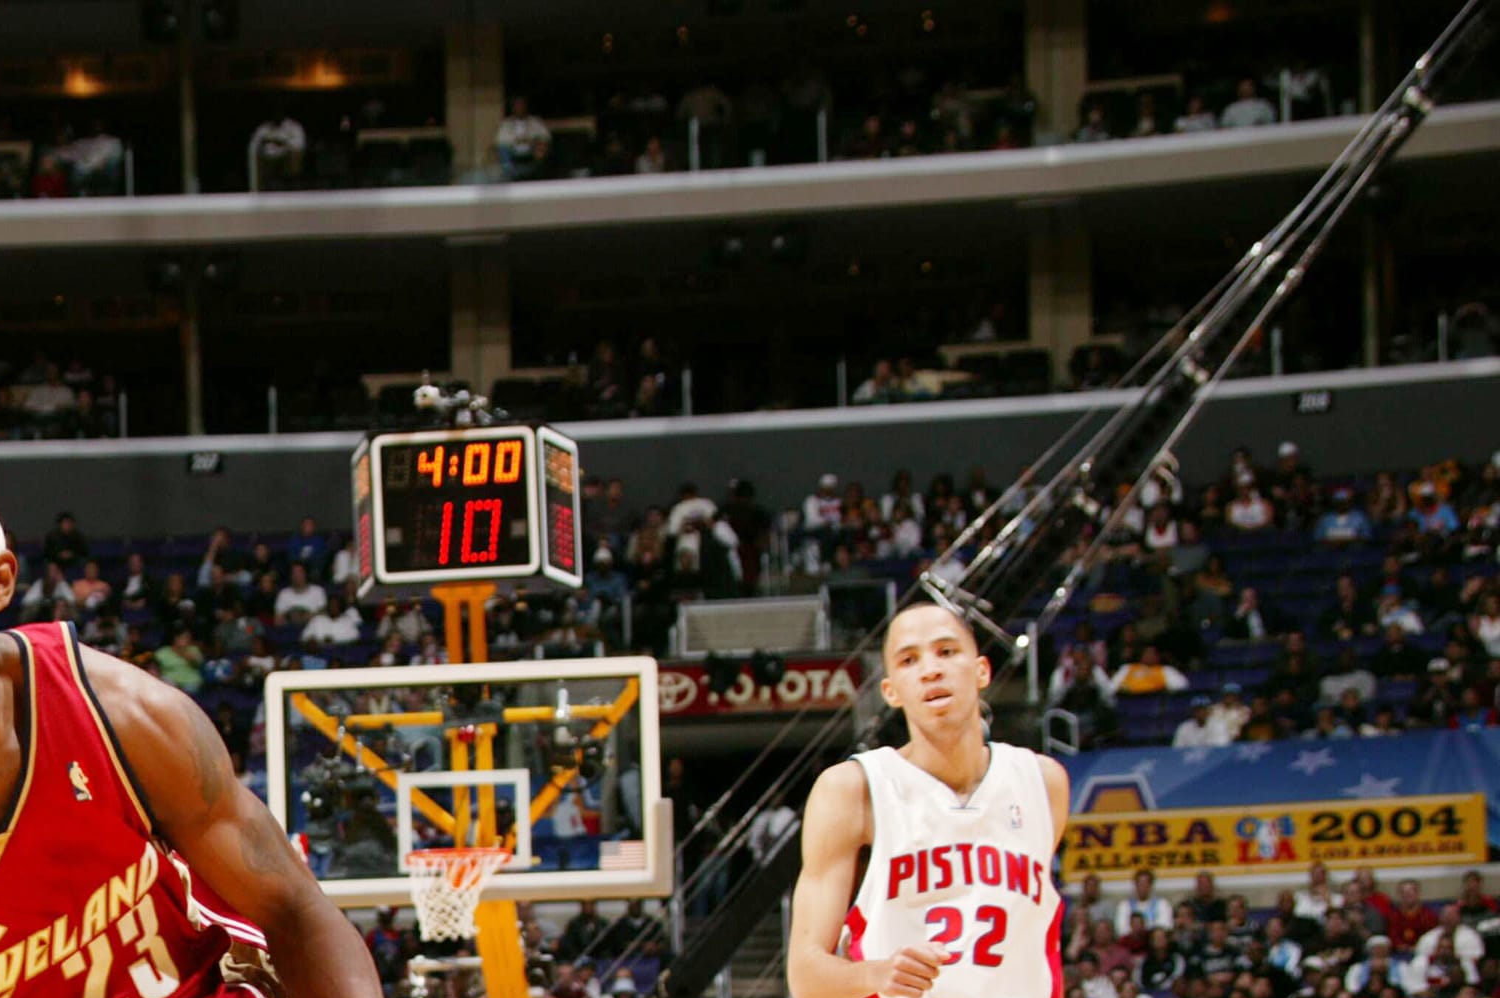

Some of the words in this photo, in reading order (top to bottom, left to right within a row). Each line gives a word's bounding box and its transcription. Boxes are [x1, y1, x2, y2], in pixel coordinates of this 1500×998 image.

[417, 440, 522, 488] 4:00
[438, 498, 503, 564] 10
[701, 669, 858, 705] OOTA
[1074, 818, 1220, 848] NBA
[1309, 805, 1465, 843] 2004
[887, 843, 1044, 906] PISTONS
[924, 904, 1008, 967] 22
